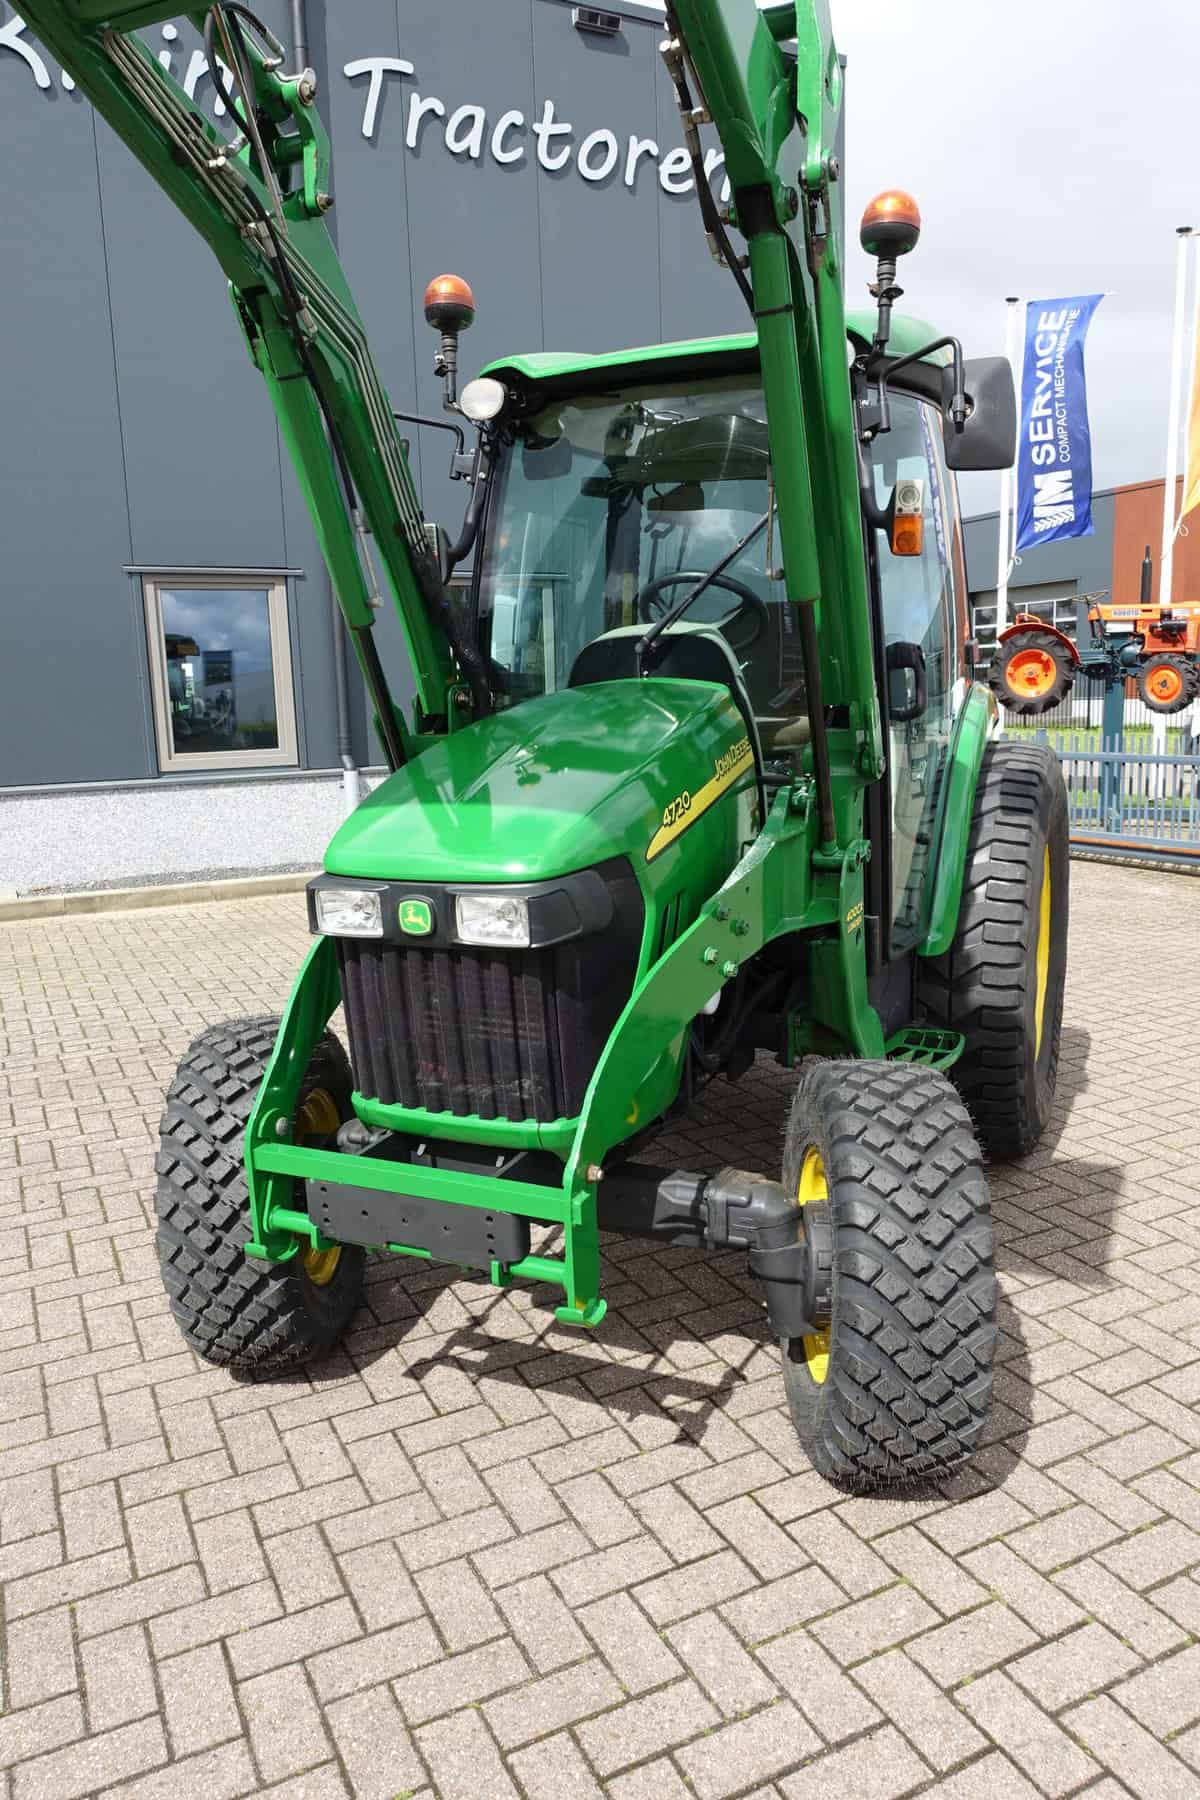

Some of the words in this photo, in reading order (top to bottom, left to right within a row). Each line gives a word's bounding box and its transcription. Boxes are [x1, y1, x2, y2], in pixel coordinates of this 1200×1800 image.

[344, 57, 731, 202] Tractoren
[1029, 309, 1068, 466] SERVICE
[1056, 401, 1072, 463] COMPACT
[662, 790, 691, 827] 4720
